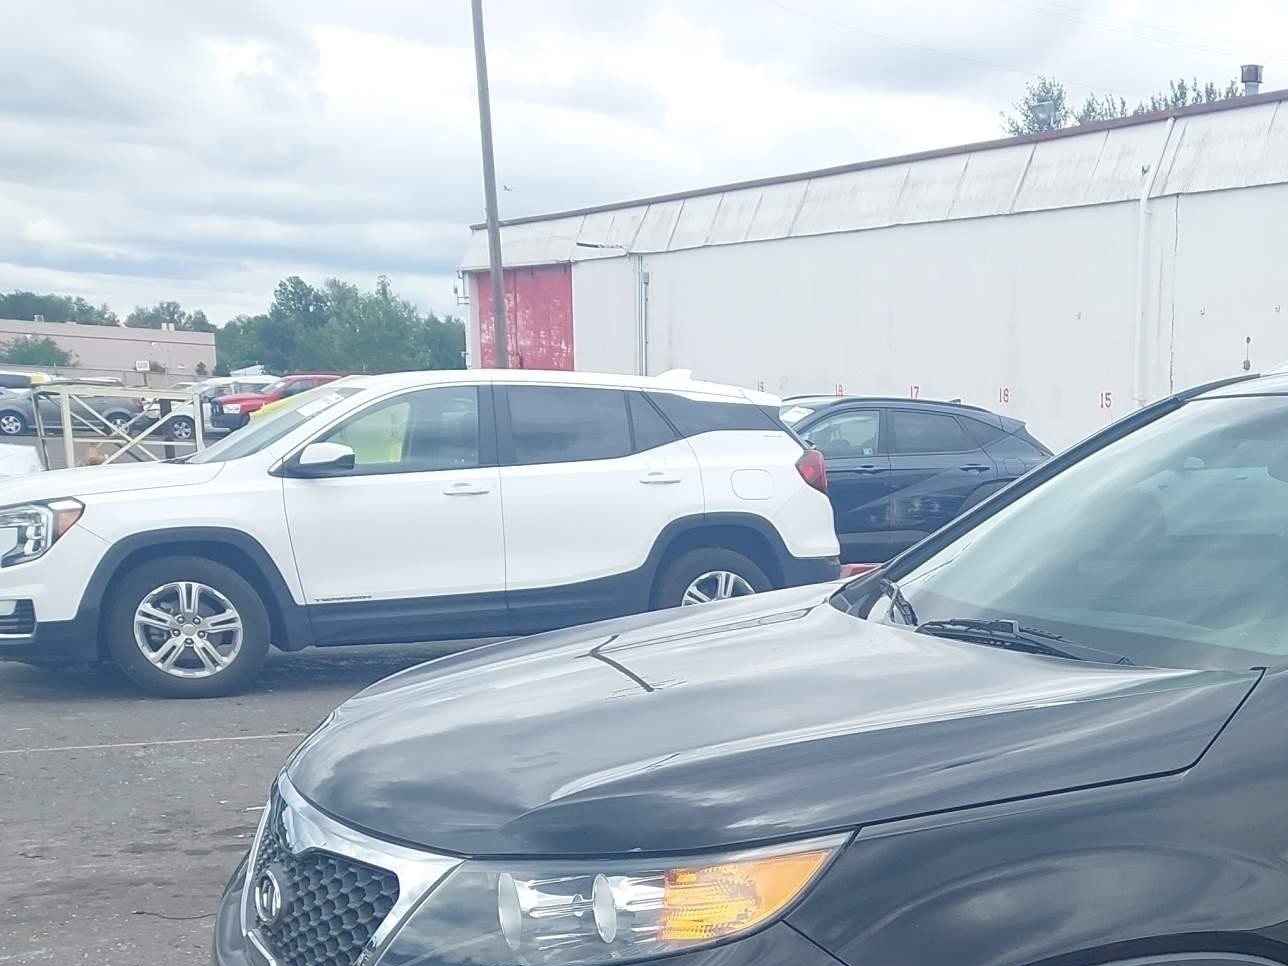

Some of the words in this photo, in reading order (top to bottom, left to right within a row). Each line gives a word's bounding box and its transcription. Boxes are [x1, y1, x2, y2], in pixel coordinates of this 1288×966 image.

[910, 385, 920, 399] 17
[999, 388, 1010, 403] 16
[1099, 392, 1112, 408] 15
